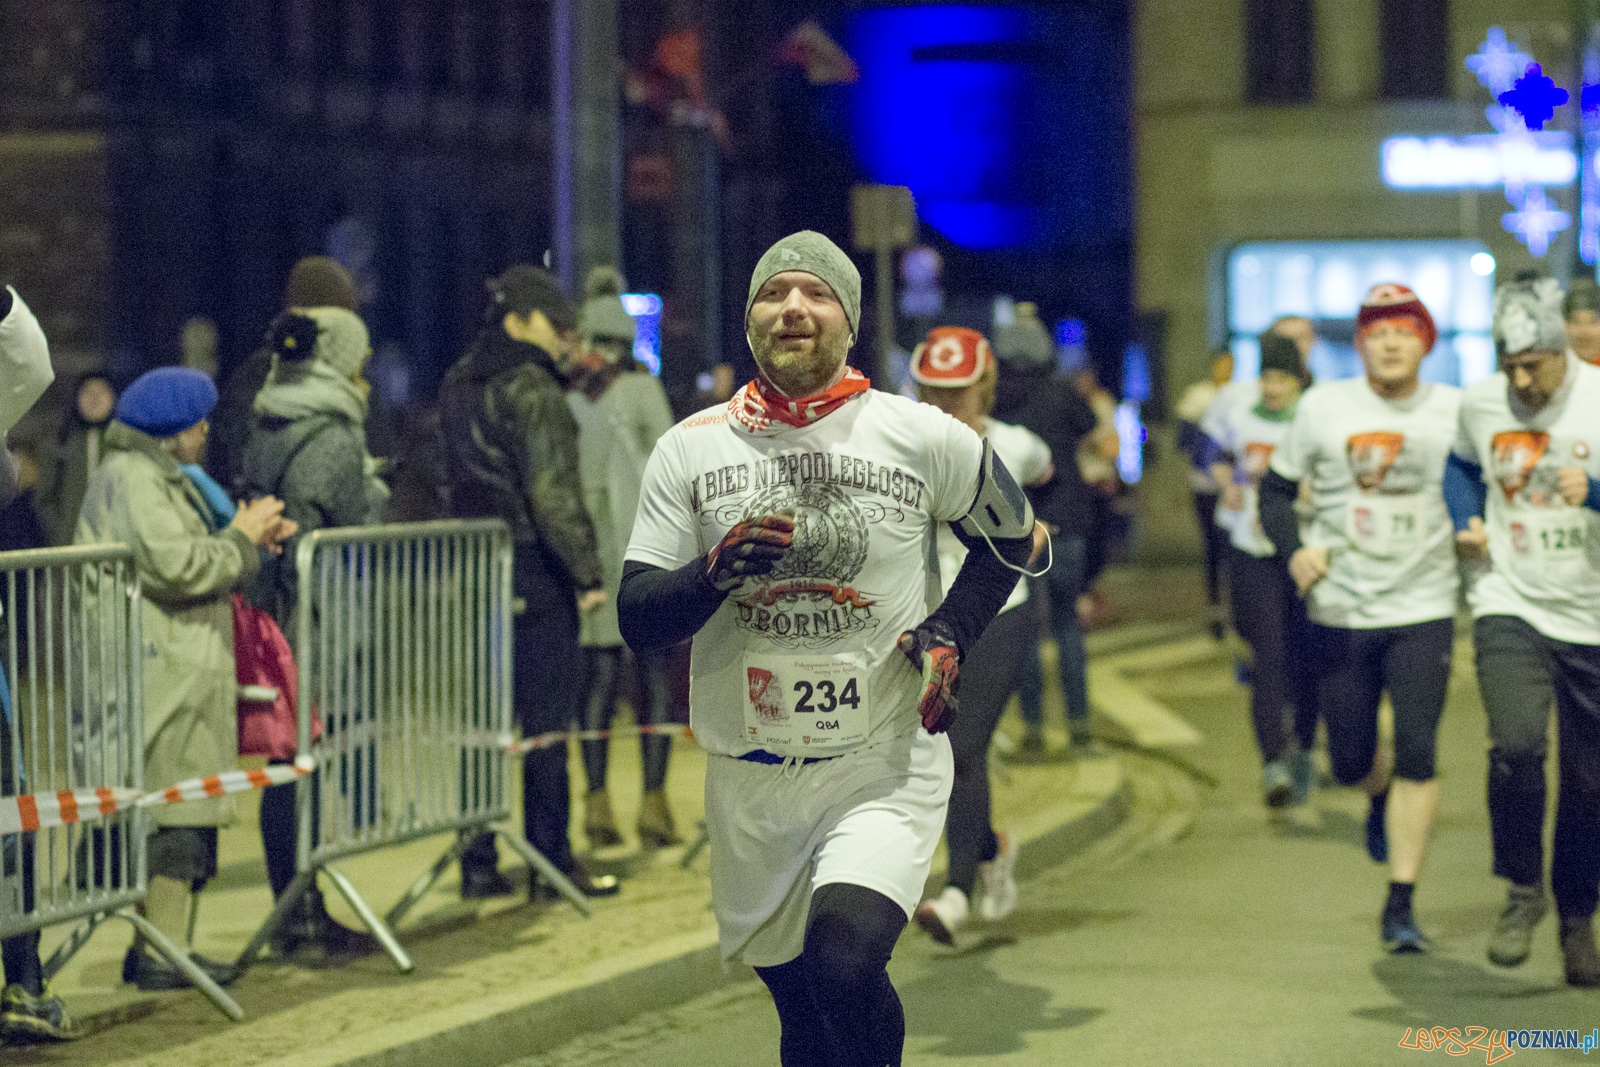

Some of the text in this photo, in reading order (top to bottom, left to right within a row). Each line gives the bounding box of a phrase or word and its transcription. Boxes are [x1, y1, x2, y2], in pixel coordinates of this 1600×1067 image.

[705, 463, 749, 502] BIEG
[754, 452, 926, 511] NIEPODLEGŁOŚCI
[793, 677, 861, 713] 234
[815, 720, 840, 731] QBA
